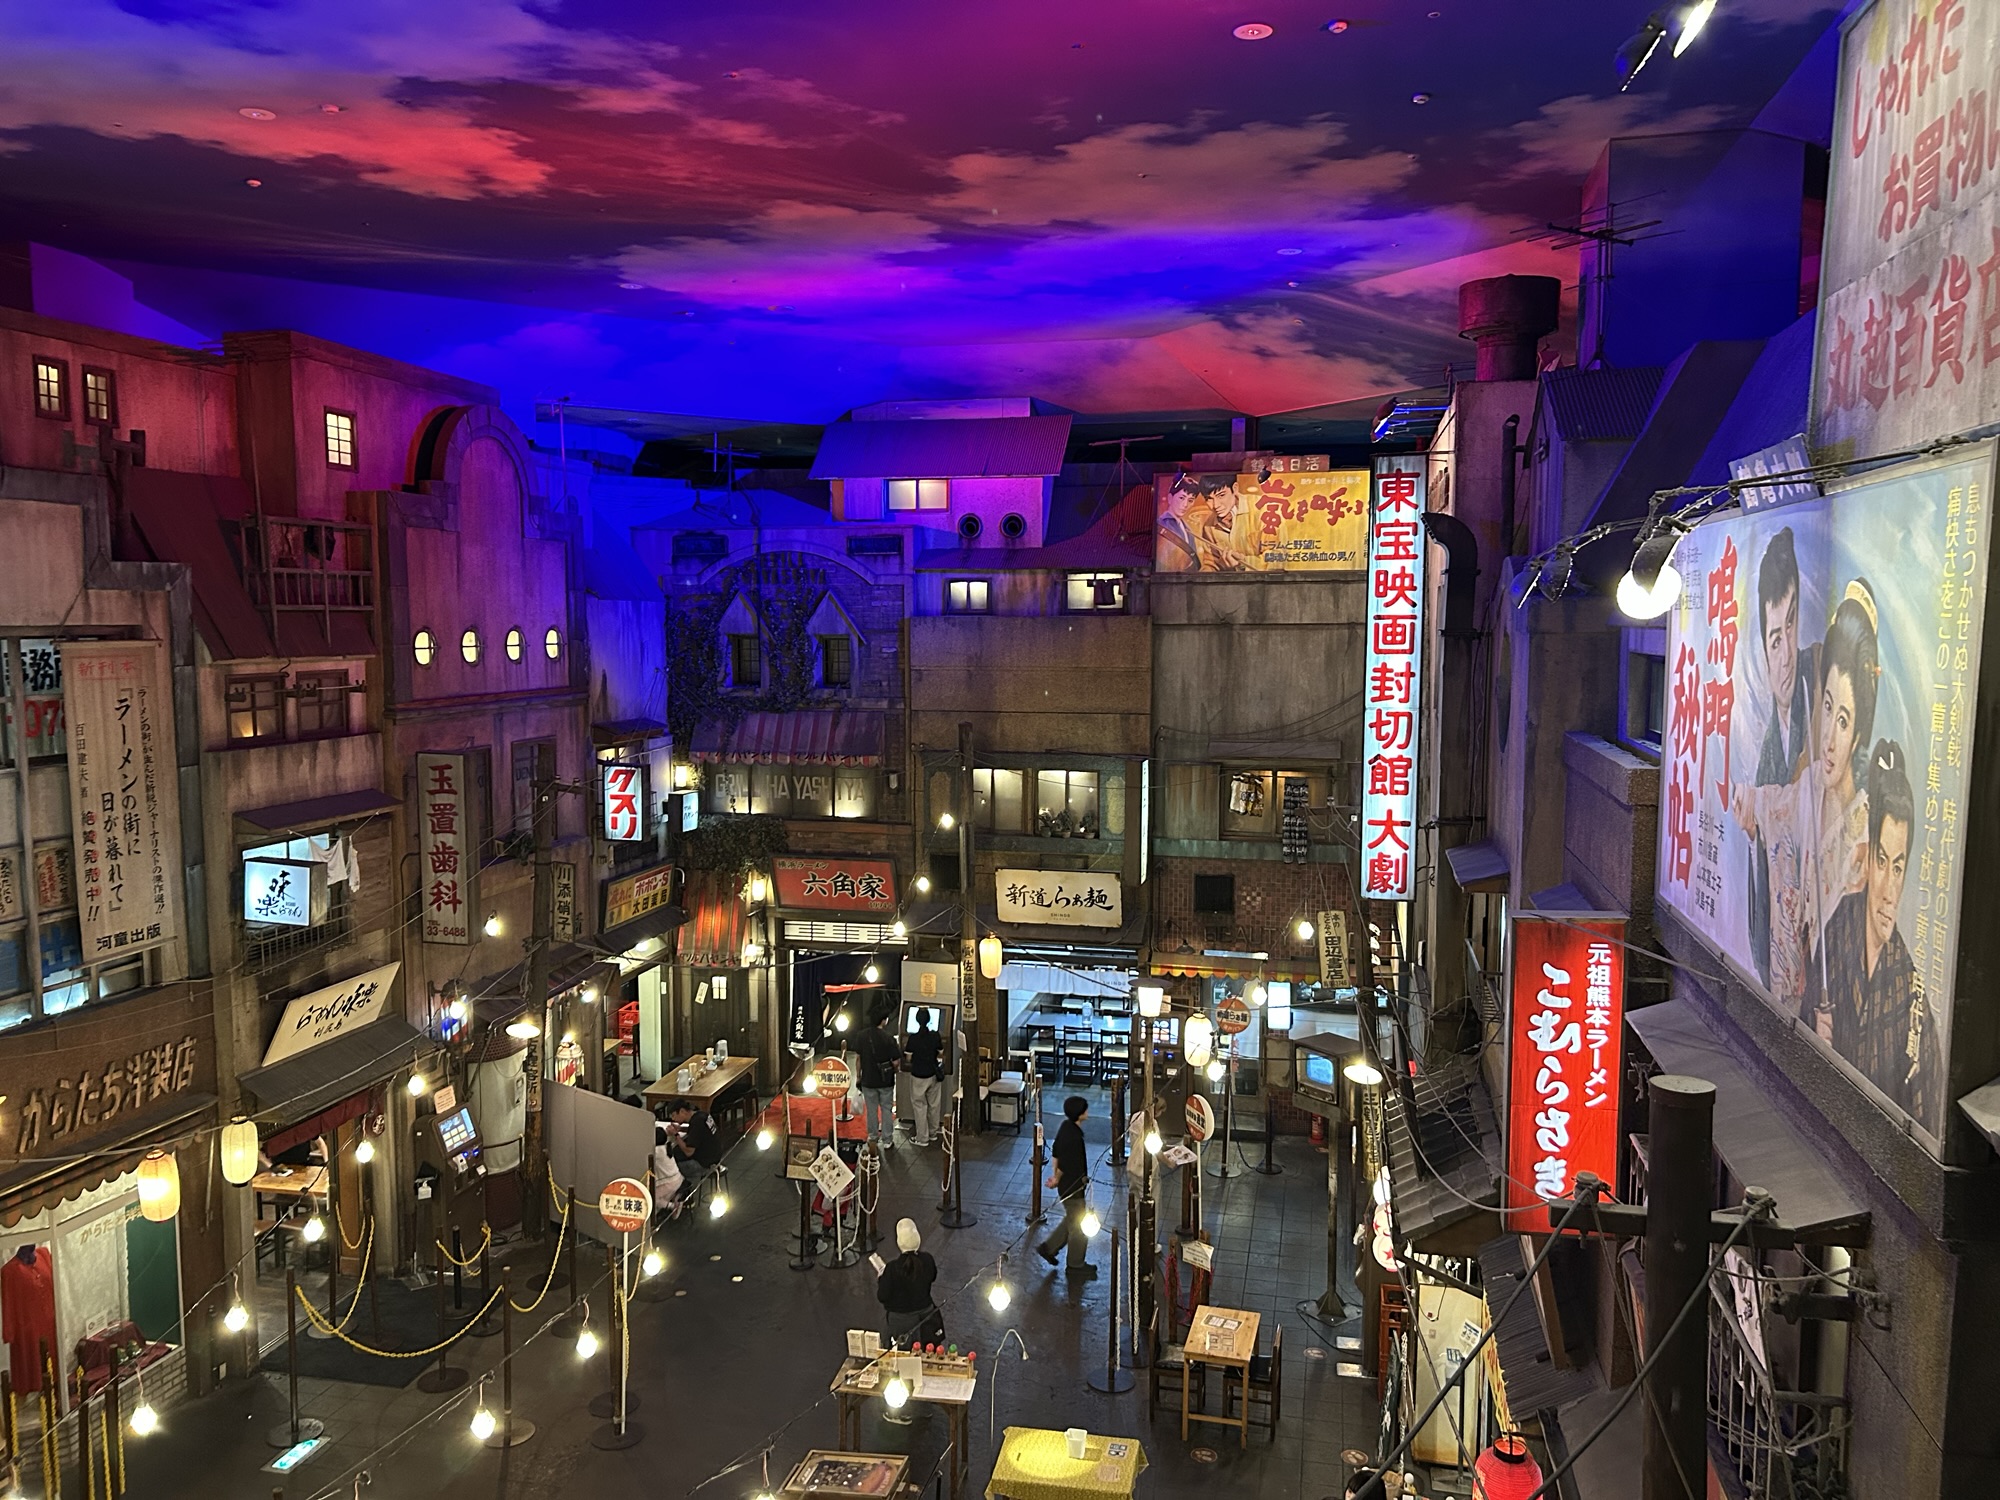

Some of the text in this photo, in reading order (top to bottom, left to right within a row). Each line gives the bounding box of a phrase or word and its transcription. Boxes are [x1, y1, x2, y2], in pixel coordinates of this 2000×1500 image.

[78, 661, 136, 676] 新刊本
[607, 770, 637, 839] クスリ
[426, 763, 463, 915] 玉置歯科
[557, 866, 572, 931] 川添硝子
[801, 870, 890, 902] 六角家
[1004, 883, 1114, 911] 新道らぁ麺
[96, 922, 162, 952] 河童出版
[426, 926, 466, 937] 33-6488
[1584, 943, 1612, 1108] 元祖熊本ラーメン
[827, 1060, 834, 1070] 3
[1528, 962, 1582, 1200] こむらさき
[18, 1035, 197, 1154] からたち洋装店
[620, 1183, 627, 1195] 2
